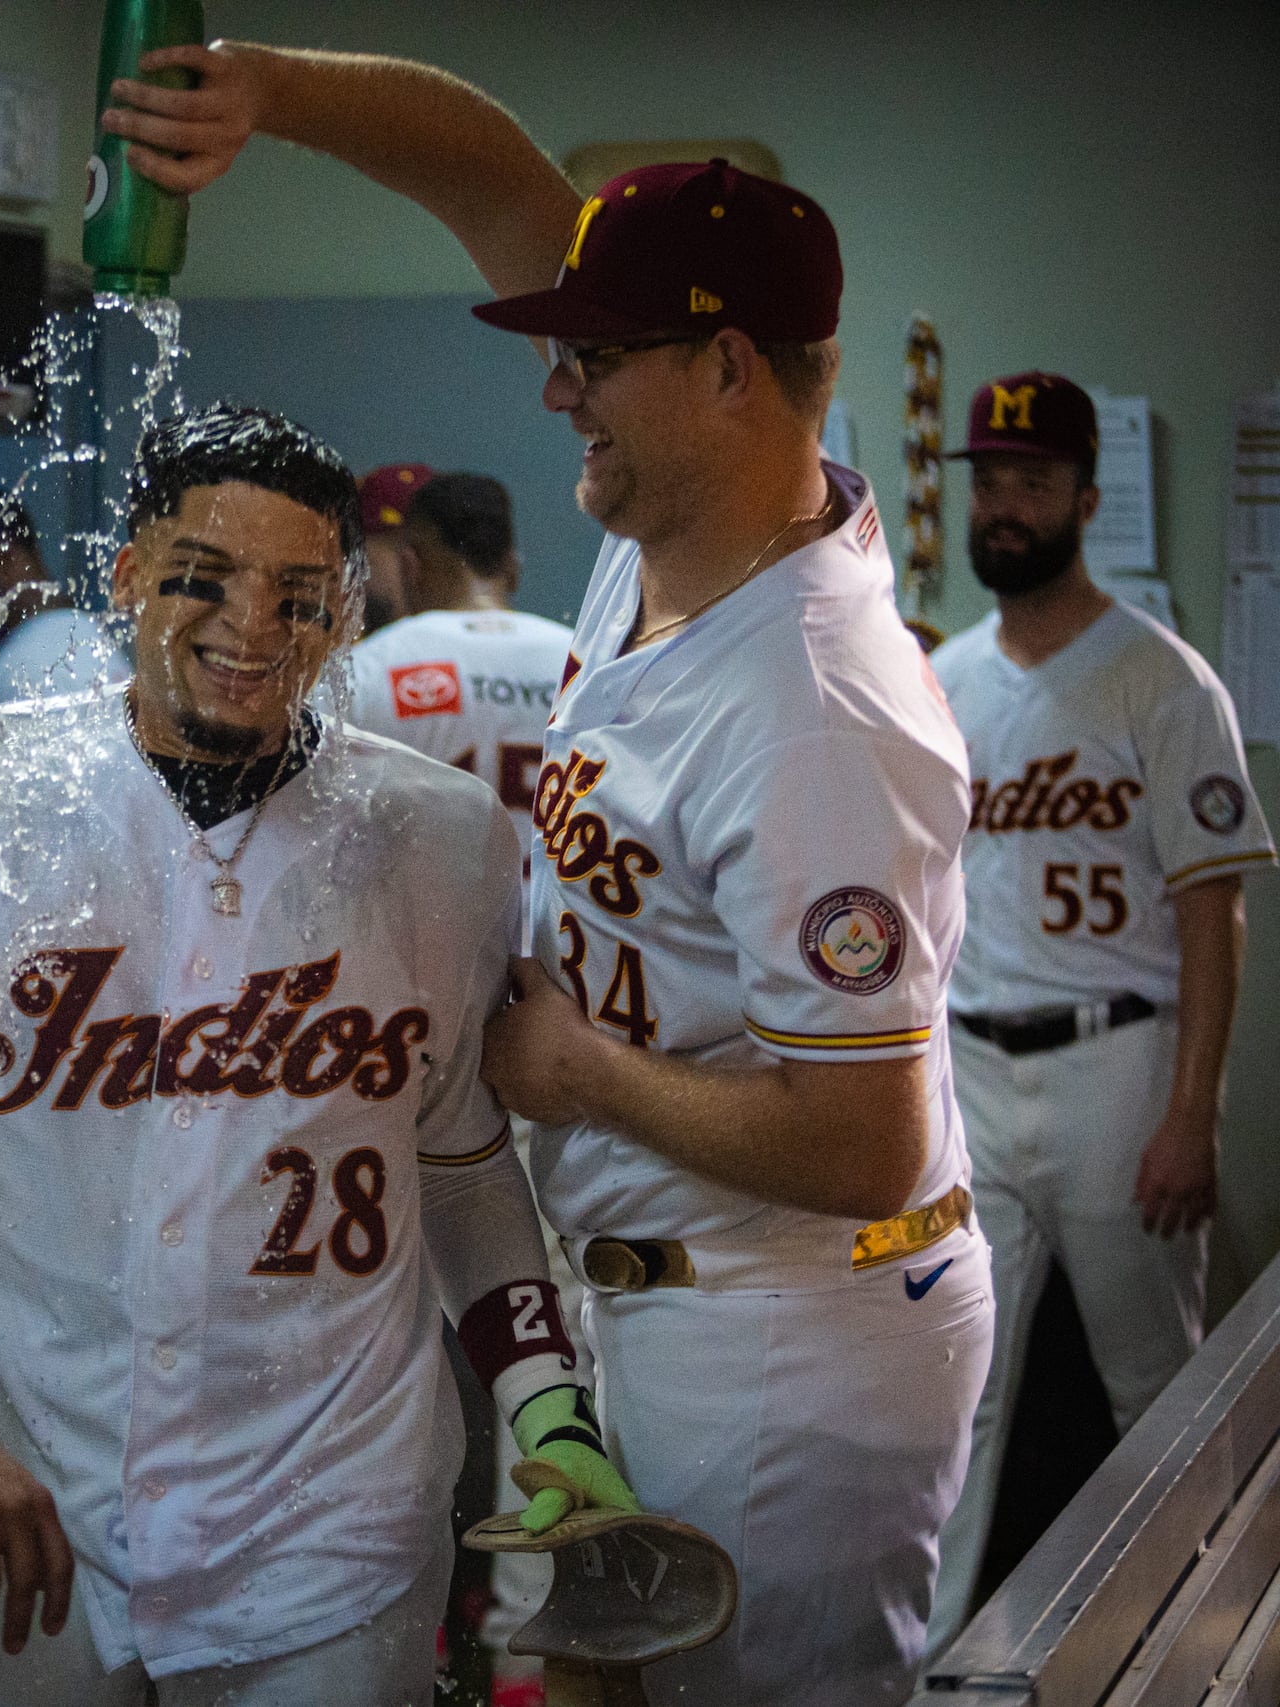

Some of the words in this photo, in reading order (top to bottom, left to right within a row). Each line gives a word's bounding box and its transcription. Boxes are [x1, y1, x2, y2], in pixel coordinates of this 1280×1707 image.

[988, 385, 1038, 430] M
[473, 674, 553, 706] TOYO
[532, 747, 663, 920] dios
[1041, 861, 1129, 935] 55
[248, 1146, 390, 1278] 28
[507, 1285, 573, 1343] 2
